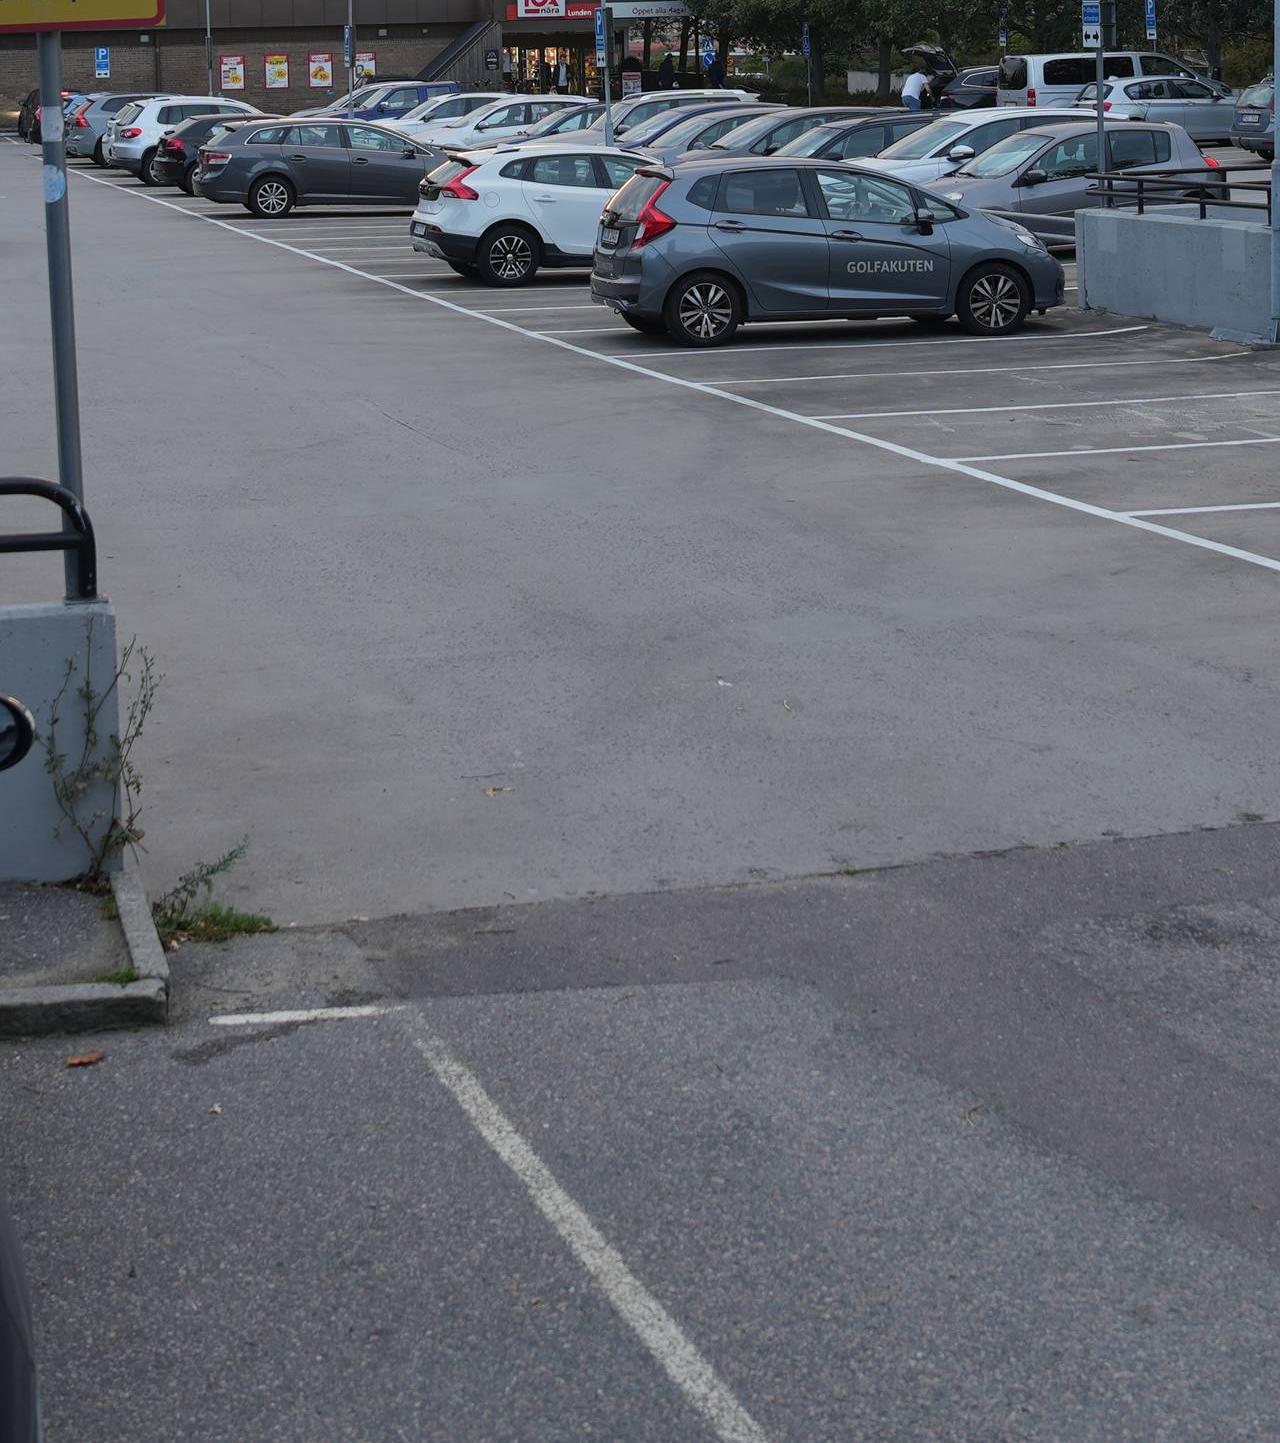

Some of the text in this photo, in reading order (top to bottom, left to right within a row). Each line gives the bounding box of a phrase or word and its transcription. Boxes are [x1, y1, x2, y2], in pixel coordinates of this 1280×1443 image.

[540, 6, 560, 14] nära
[568, 9, 592, 17] Lunden
[847, 260, 934, 274] GOLFAKUTEN
